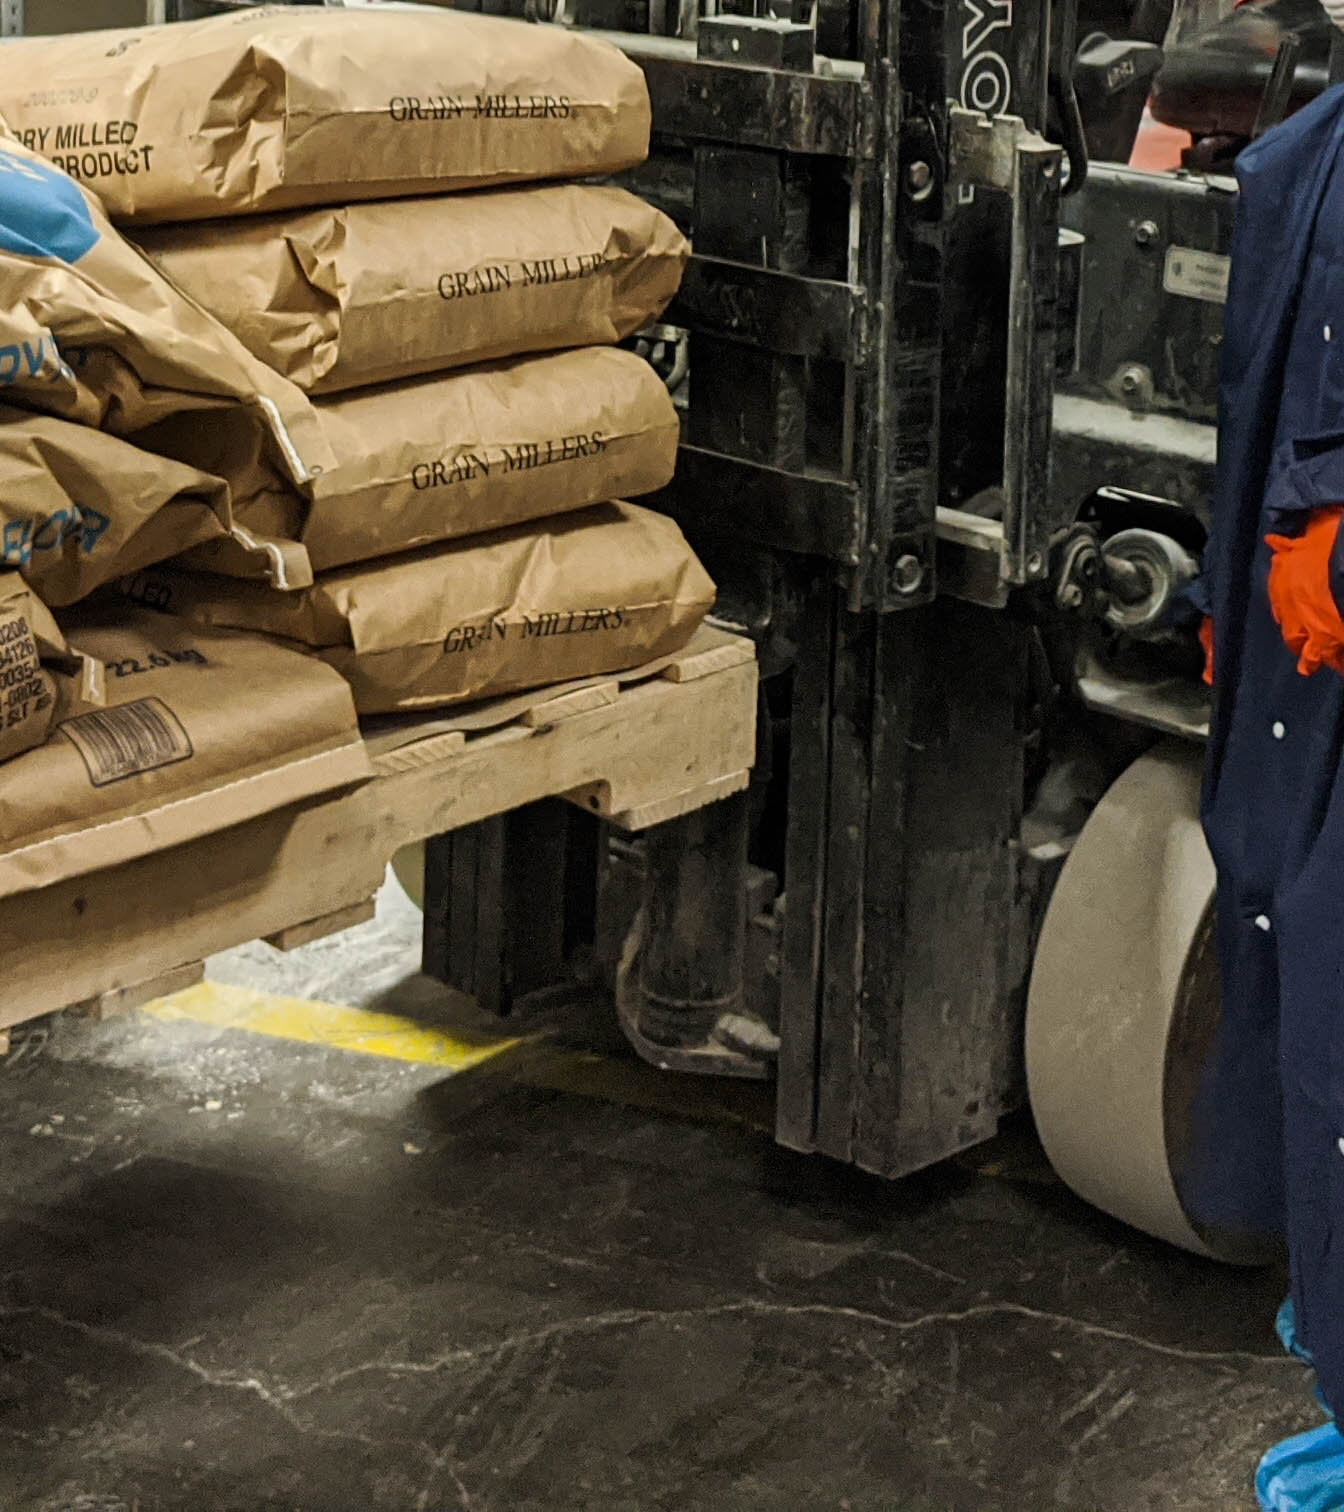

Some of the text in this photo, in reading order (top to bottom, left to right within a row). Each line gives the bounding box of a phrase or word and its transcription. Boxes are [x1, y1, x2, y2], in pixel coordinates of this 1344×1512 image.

[389, 94, 571, 122] GRAIN MILLERS
[56, 120, 139, 150] MILLED
[437, 251, 608, 300] GRAIN MILLER
[412, 431, 604, 490] GRAIN MILLERS
[521, 606, 625, 639] MILLERS
